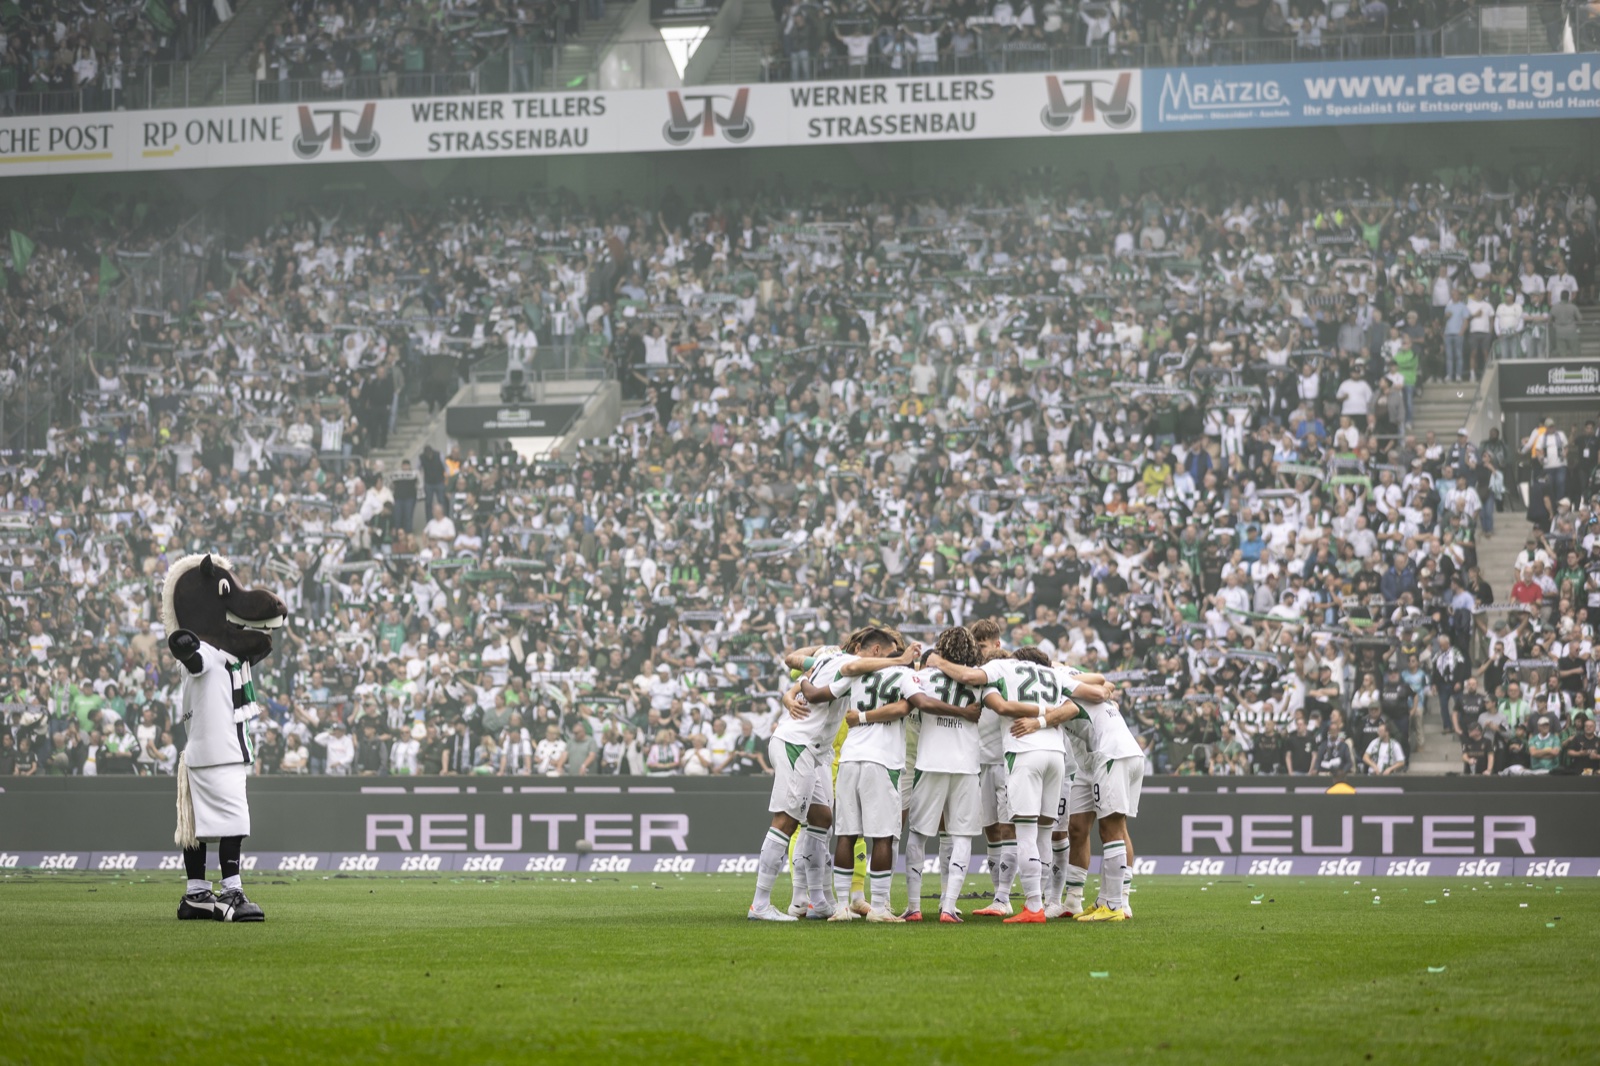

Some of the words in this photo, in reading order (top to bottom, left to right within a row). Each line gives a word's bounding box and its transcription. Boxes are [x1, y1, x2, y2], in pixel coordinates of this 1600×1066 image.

[790, 83, 888, 107] WERNER
[896, 79, 995, 103] TELLERS
[411, 99, 504, 123] WERNER
[512, 95, 606, 119] TELLERS
[1303, 104, 1322, 116] Ihr
[1326, 103, 1393, 117] Spezialist
[1396, 101, 1416, 113] für
[1420, 101, 1502, 113] Entsorgung,
[1507, 98, 1534, 109] Bau
[1538, 97, 1563, 109] und
[143, 121, 178, 147] RP
[185, 116, 283, 145] ONLINE
[808, 112, 976, 138] STRASSENBAU
[49, 124, 114, 152] POST
[427, 127, 589, 153] STRASSENBAU
[857, 671, 903, 712] 34
[929, 672, 977, 707] 36
[1014, 666, 1059, 705] 29
[365, 813, 690, 851] REUTER
[1181, 814, 1536, 854] REUTER
[39, 852, 78, 869] ista
[98, 852, 139, 869] ista
[159, 853, 184, 869] ist
[277, 853, 319, 870] ista
[338, 853, 380, 871] ista
[401, 853, 442, 871] ista
[462, 854, 504, 871] ista
[525, 854, 567, 871] ista
[589, 854, 632, 872] ista
[653, 855, 696, 872] ista
[717, 855, 759, 872] ista
[1180, 857, 1225, 875] ista
[1248, 857, 1293, 875] ista
[1317, 857, 1362, 876] ista
[1386, 858, 1431, 876] ista
[1456, 858, 1501, 876] ista
[1526, 858, 1571, 877] ista
